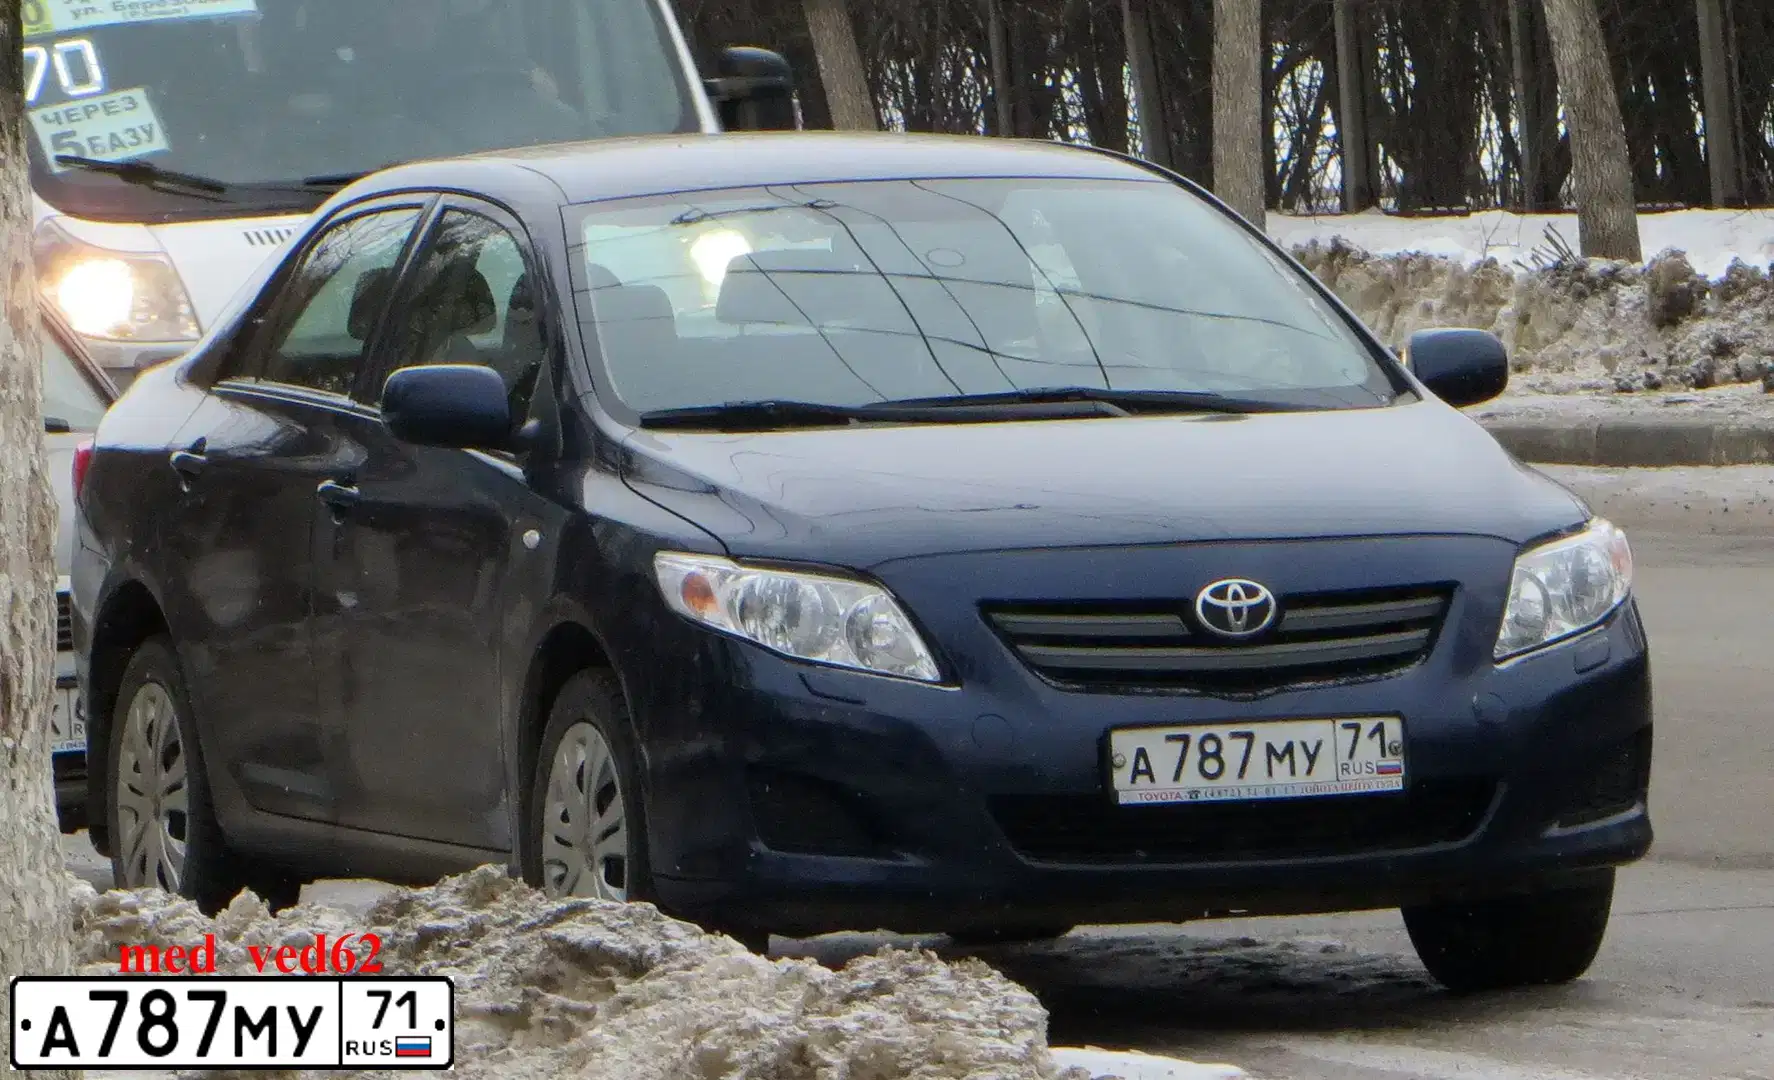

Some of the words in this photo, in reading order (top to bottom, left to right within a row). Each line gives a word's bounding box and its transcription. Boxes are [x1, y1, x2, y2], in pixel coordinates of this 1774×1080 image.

[41, 96, 138, 125] ЧЕРЕЗ
[1341, 721, 1386, 760] 71
[1340, 760, 1375, 776] RUS
[1138, 792, 1183, 801] TOYOTA
